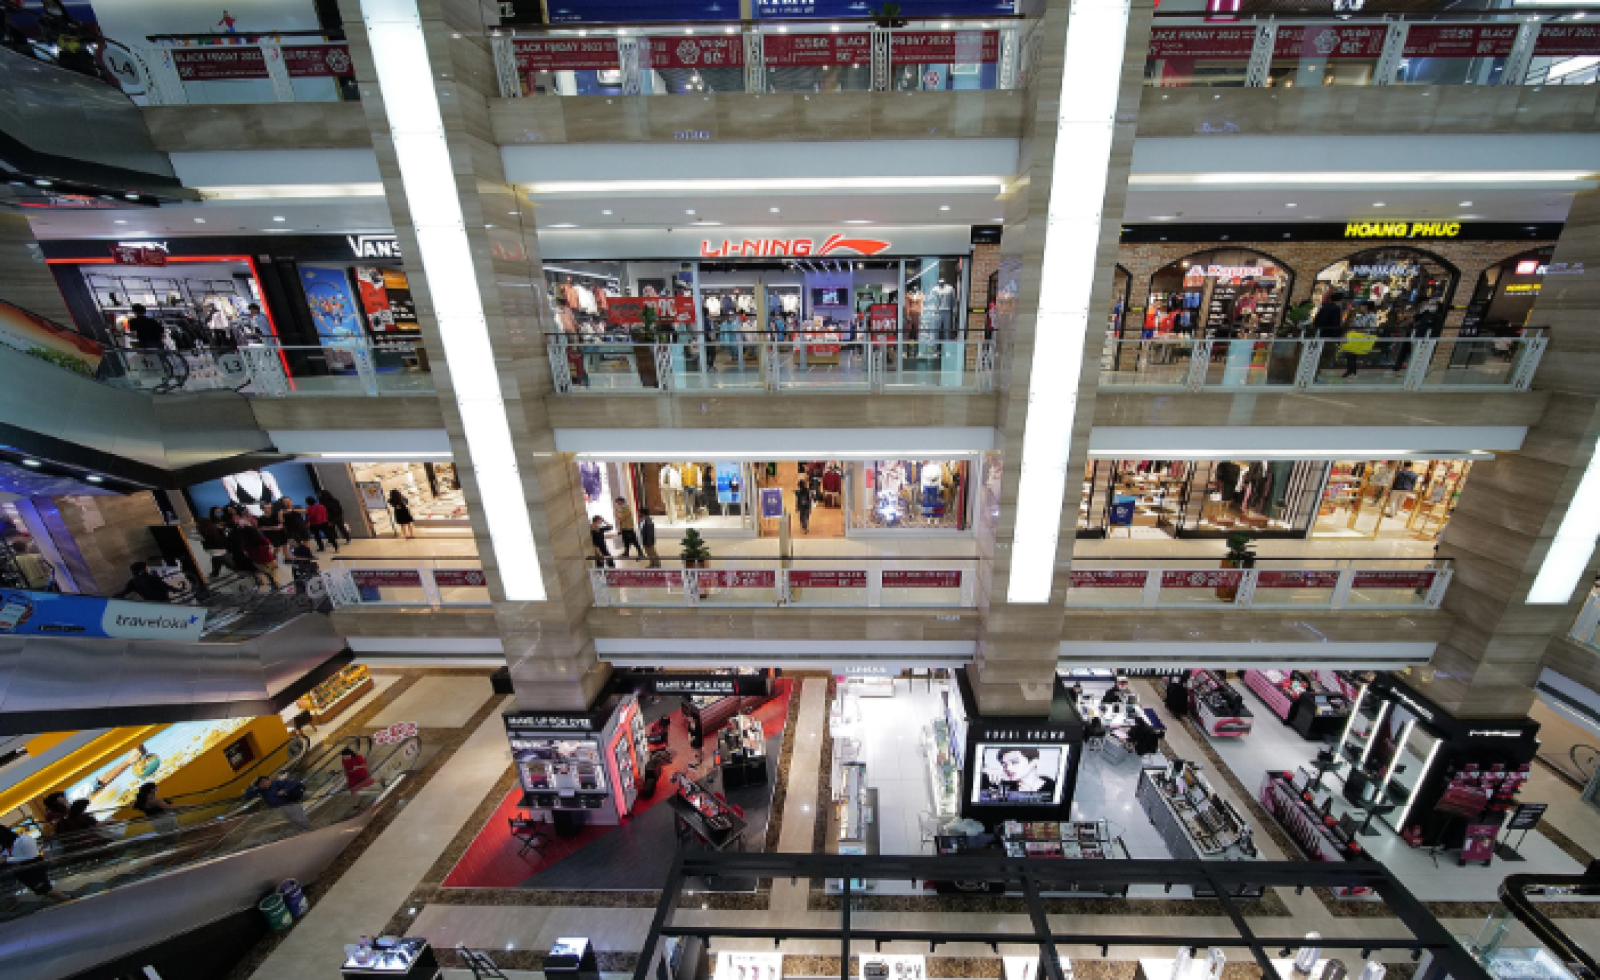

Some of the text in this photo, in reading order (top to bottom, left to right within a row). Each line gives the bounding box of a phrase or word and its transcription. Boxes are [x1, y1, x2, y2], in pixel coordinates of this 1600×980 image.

[346, 234, 402, 258] VANS
[700, 238, 813, 257] LI-NING
[115, 614, 188, 631] traveloka
